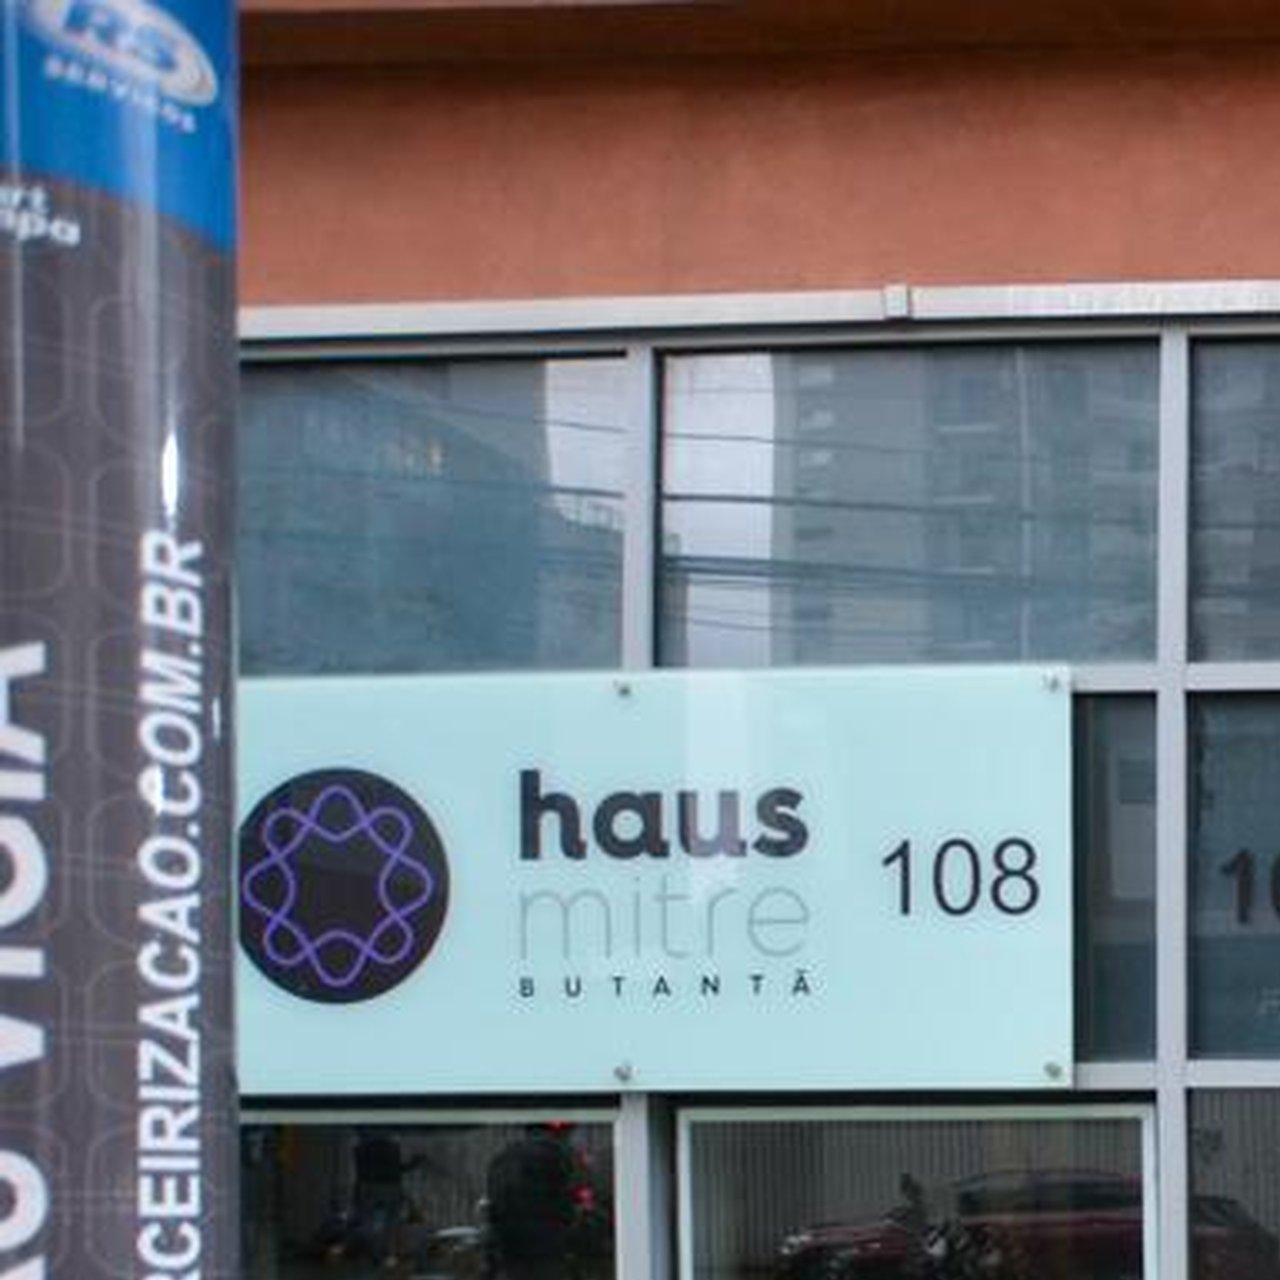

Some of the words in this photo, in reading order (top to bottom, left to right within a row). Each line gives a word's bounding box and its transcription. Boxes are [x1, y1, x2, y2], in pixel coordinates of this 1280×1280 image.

[519, 769, 809, 862] haus
[519, 871, 809, 960] mitre
[881, 838, 1041, 917] 108
[519, 967, 811, 999] BUTANTÃ
